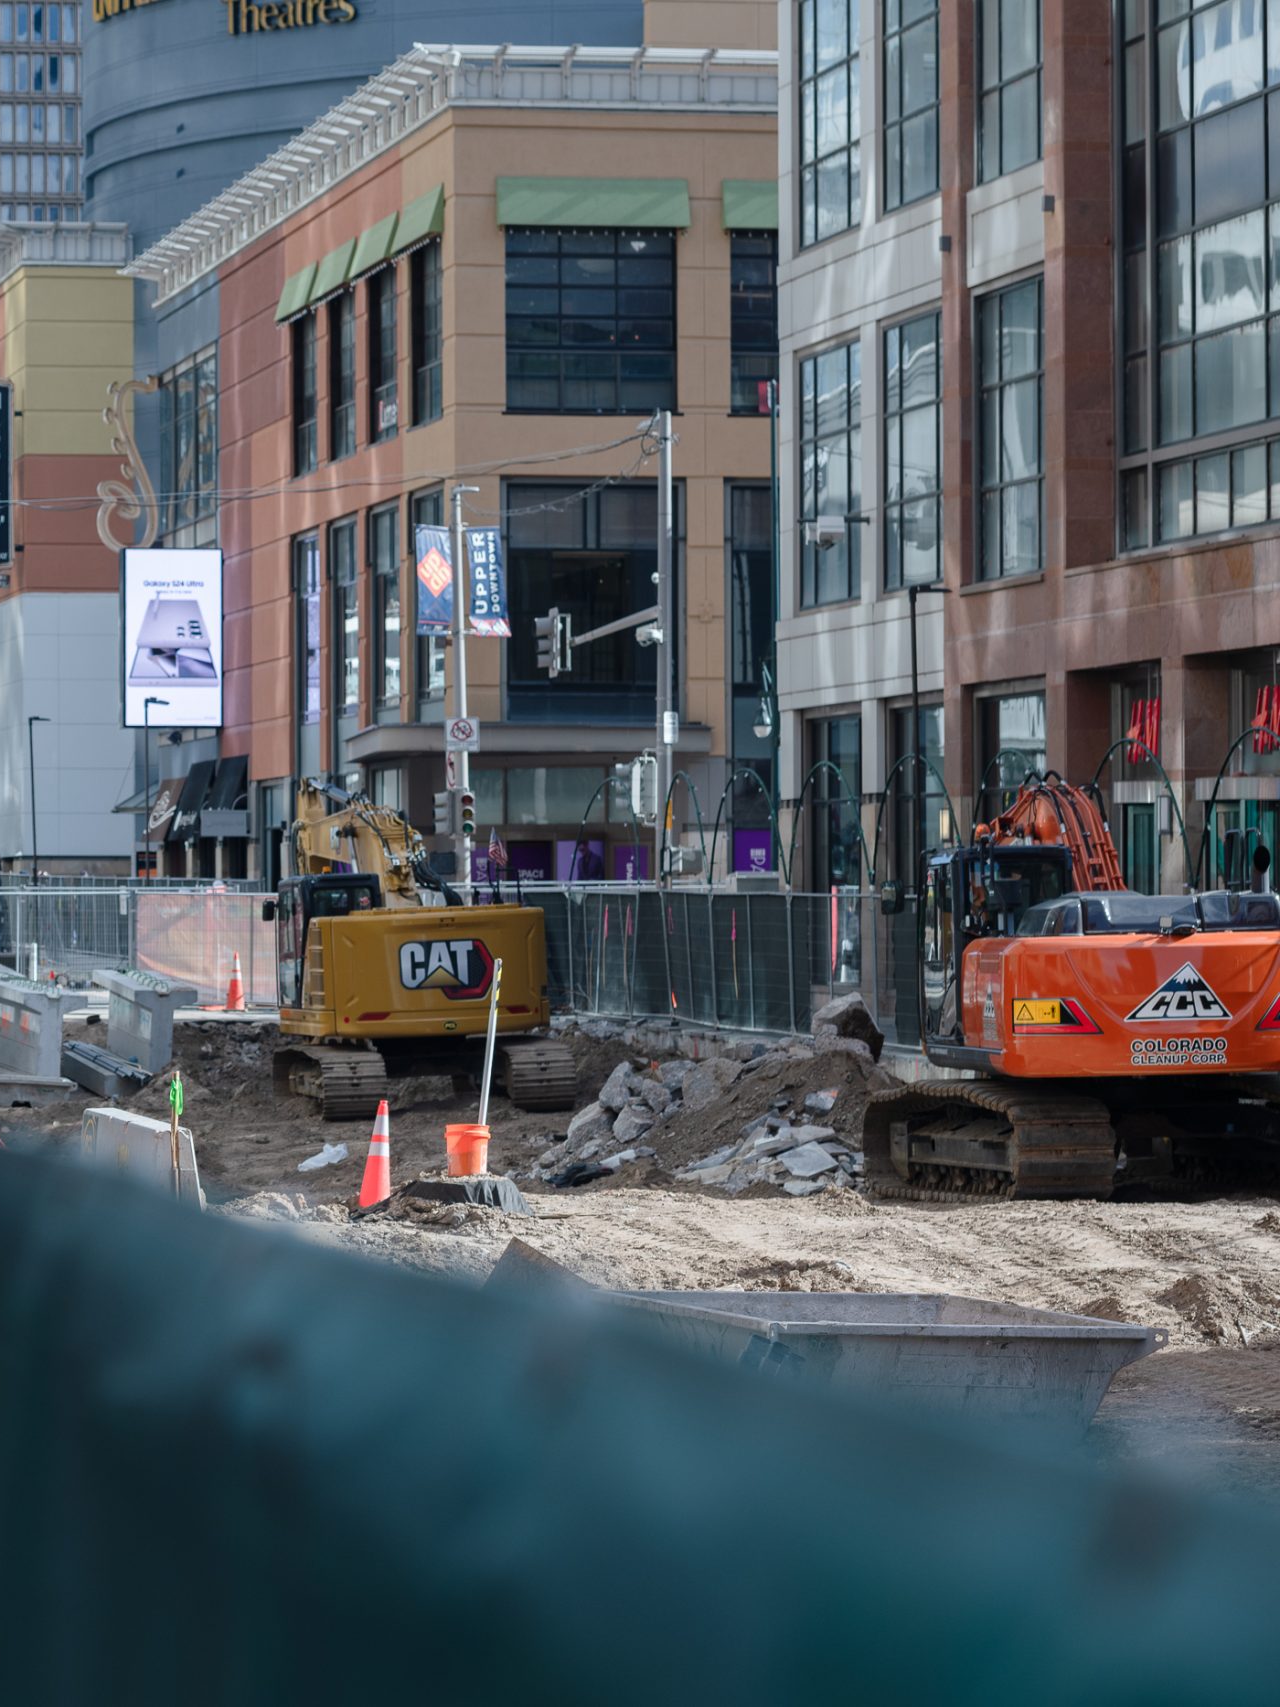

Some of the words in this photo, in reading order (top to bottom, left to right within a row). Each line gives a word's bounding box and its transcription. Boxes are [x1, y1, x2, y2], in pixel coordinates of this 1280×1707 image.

[472, 532, 488, 615] UPPER
[487, 531, 501, 613] DOWNTOWN
[400, 940, 473, 988] CAT
[1135, 990, 1224, 1018] CCC
[1131, 1037, 1227, 1053] COLORADO
[1131, 1054, 1189, 1065] CLEANUP
[1191, 1054, 1227, 1064] CORP.
